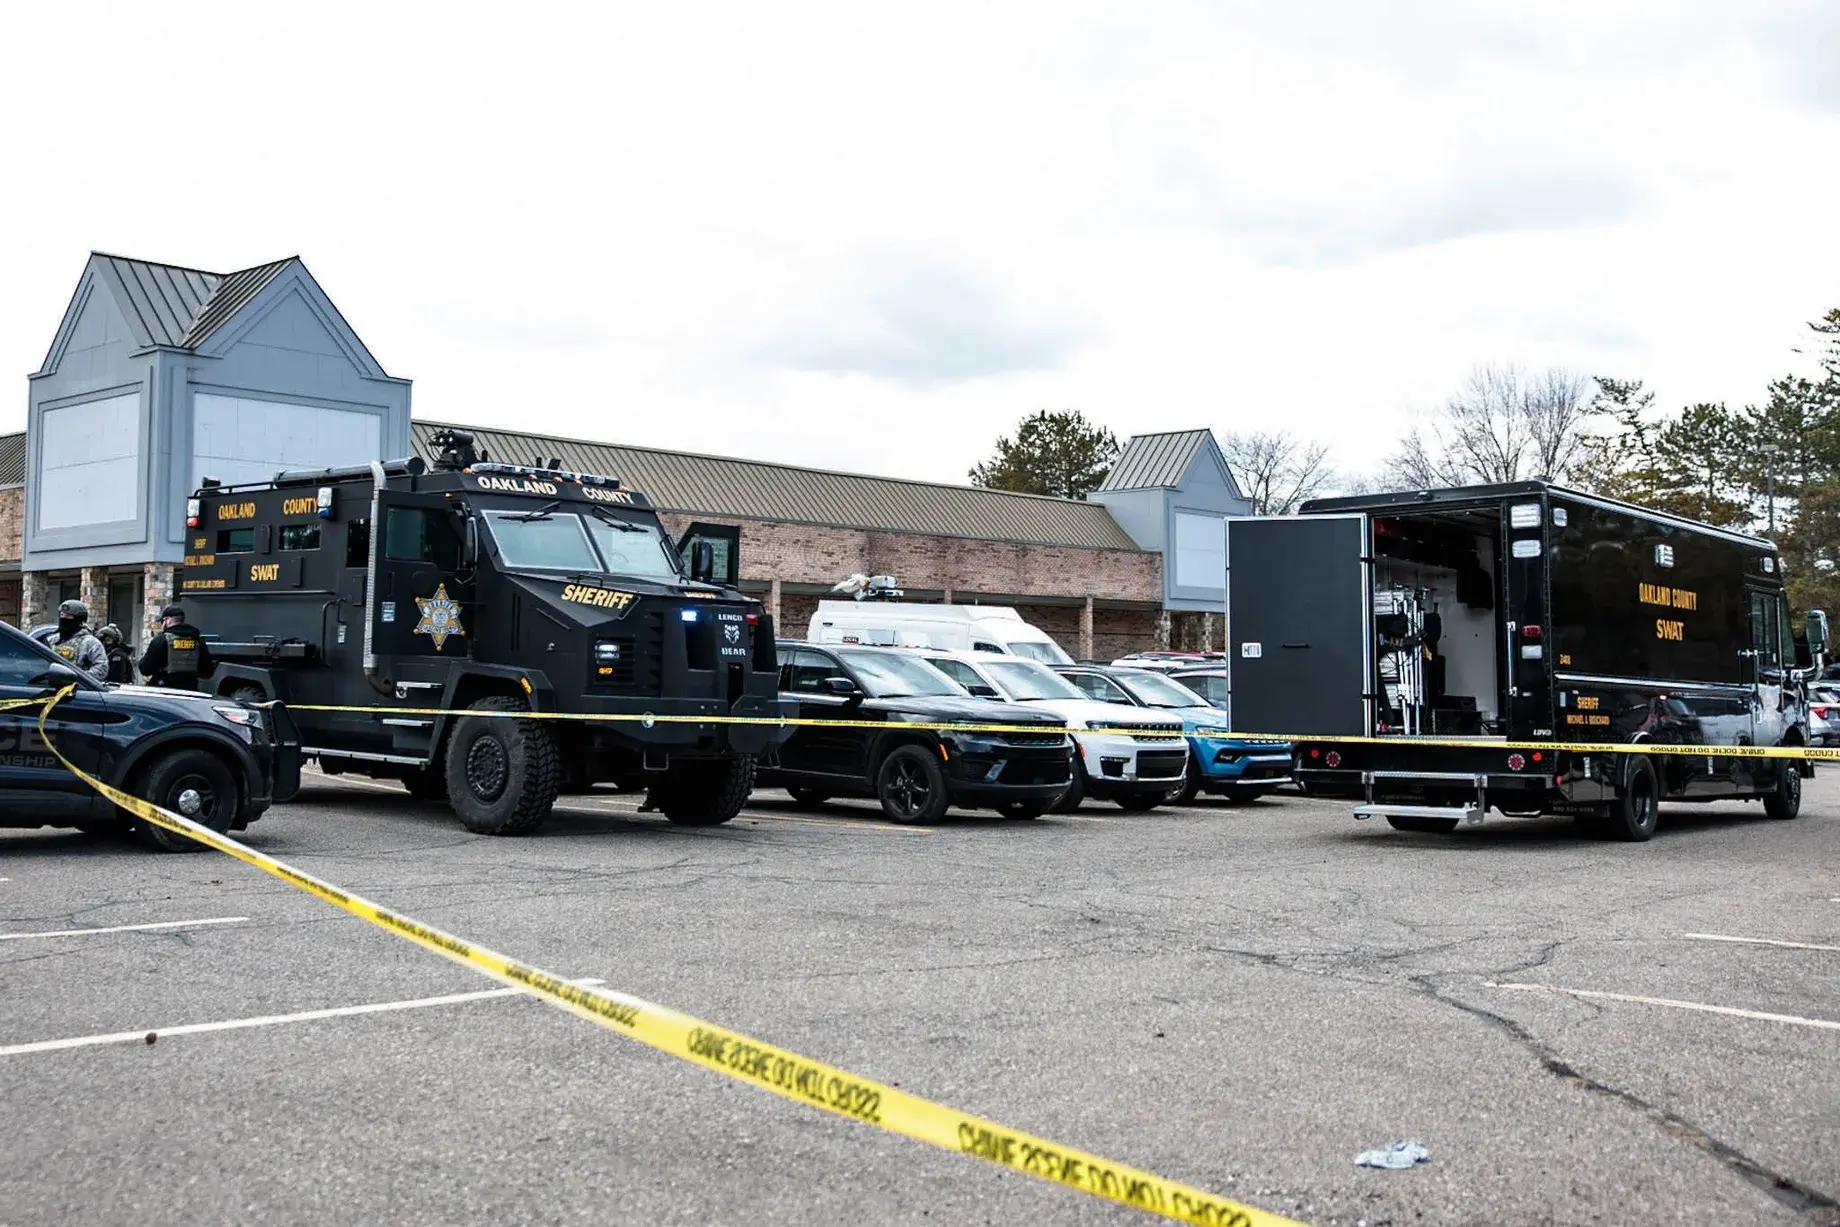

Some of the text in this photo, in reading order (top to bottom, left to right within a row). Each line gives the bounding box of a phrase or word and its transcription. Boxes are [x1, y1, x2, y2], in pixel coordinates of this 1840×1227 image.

[477, 476, 635, 505] OAKLAND COUNTY
[218, 498, 318, 520] OAKLAND COUNTY
[250, 563, 280, 581] SWAT
[561, 584, 634, 610] SHERIFF
[1639, 582, 1697, 611] OAKLAND COUNTY
[1656, 618, 1684, 641] SWAT
